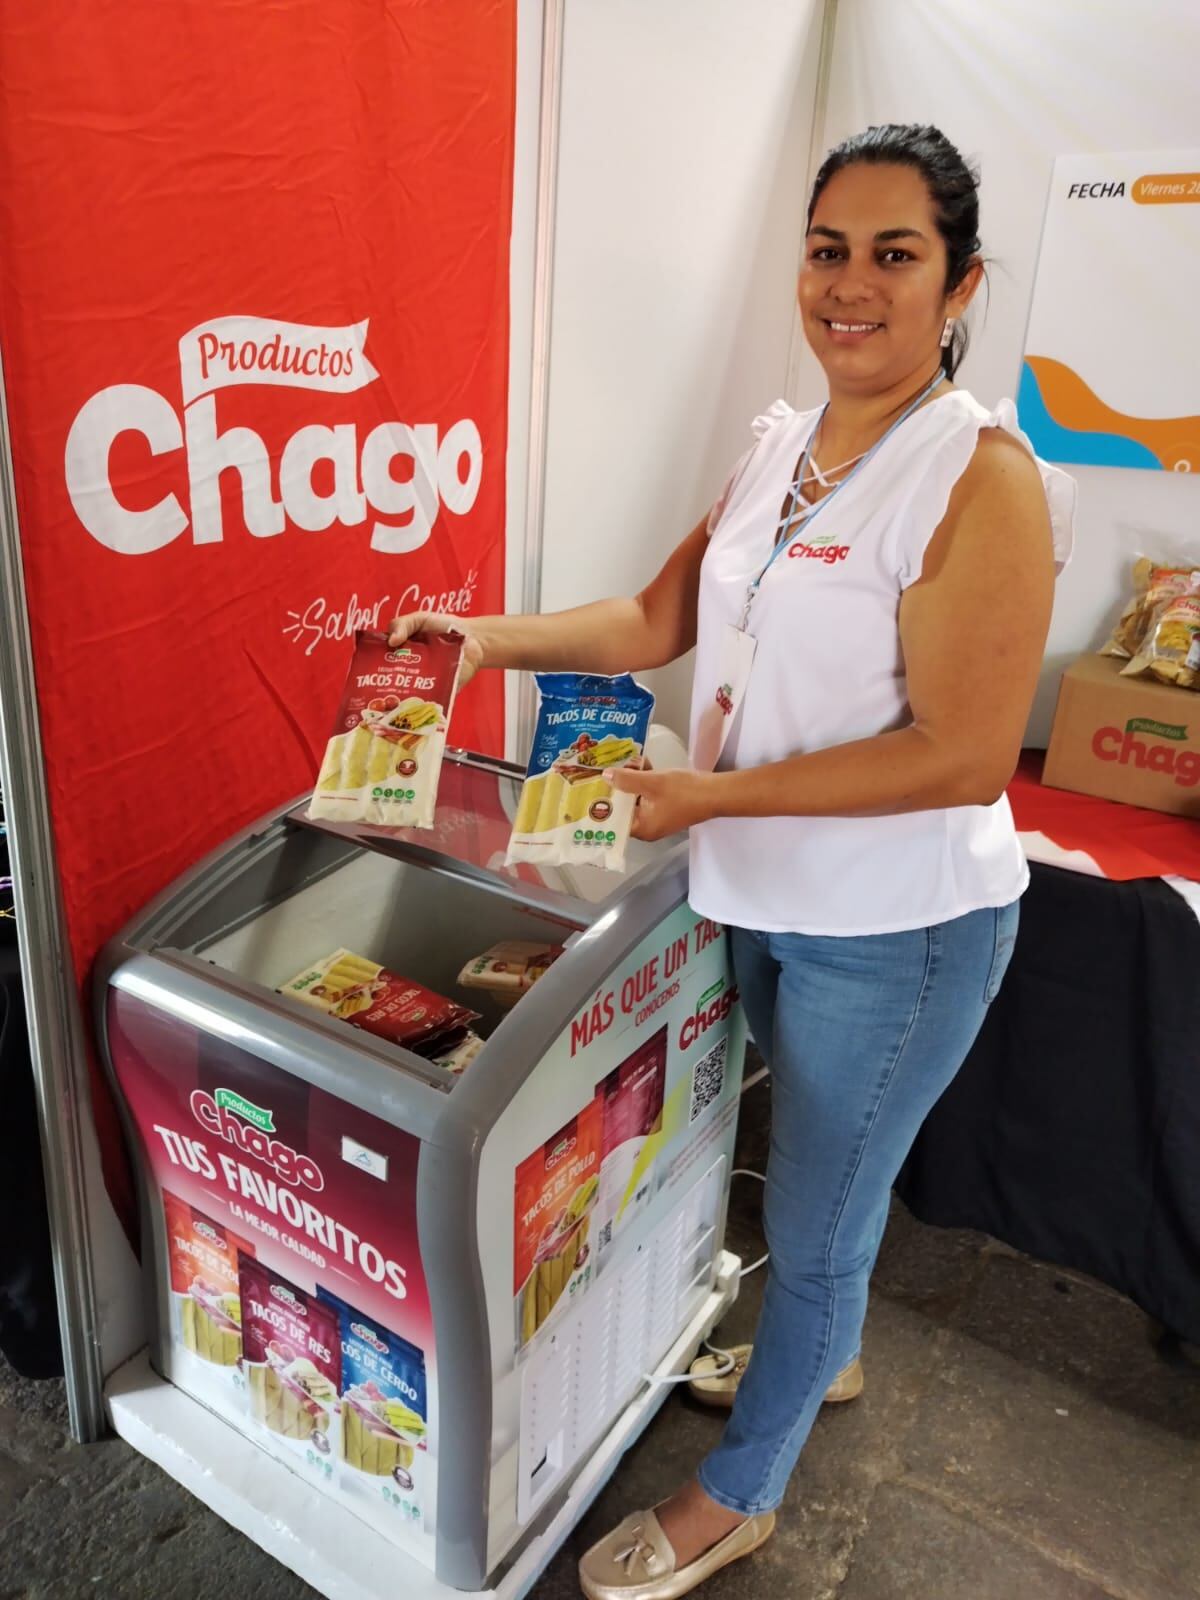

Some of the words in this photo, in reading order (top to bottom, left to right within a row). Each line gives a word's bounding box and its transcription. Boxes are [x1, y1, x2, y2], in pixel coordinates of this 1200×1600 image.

[1068, 182, 1125, 198] FECHA
[1140, 182, 1186, 196] Viernes
[198, 332, 353, 379] Productos
[65, 384, 482, 555] Chago
[788, 542, 850, 564] Chago
[302, 594, 390, 656] Sabor
[357, 674, 393, 688] TACOS
[394, 674, 413, 688] DE
[413, 676, 437, 690] RES
[546, 708, 580, 725] TACOS
[582, 708, 599, 721] DE
[600, 710, 637, 726] CERDO
[1092, 726, 1200, 788] Chag
[571, 989, 614, 1058] MÁS
[620, 956, 660, 1014] QUE
[664, 932, 689, 979] UN
[694, 919, 727, 955] TAC
[220, 1092, 266, 1125] Productos
[189, 1089, 324, 1192] Chago
[153, 1124, 217, 1180] TUS
[217, 1152, 407, 1299] FAVORITOS
[521, 1187, 553, 1227] TACOS
[568, 1151, 596, 1182] POLLO
[229, 1200, 244, 1219] LA
[244, 1209, 280, 1241] MEJOR
[281, 1232, 326, 1269] CALIDAD
[249, 1299, 287, 1332] TACOS
[289, 1323, 306, 1345] DE
[308, 1336, 332, 1364] RES
[341, 1341, 361, 1361] COS
[363, 1352, 379, 1373] DE
[380, 1366, 418, 1401] CERDO
